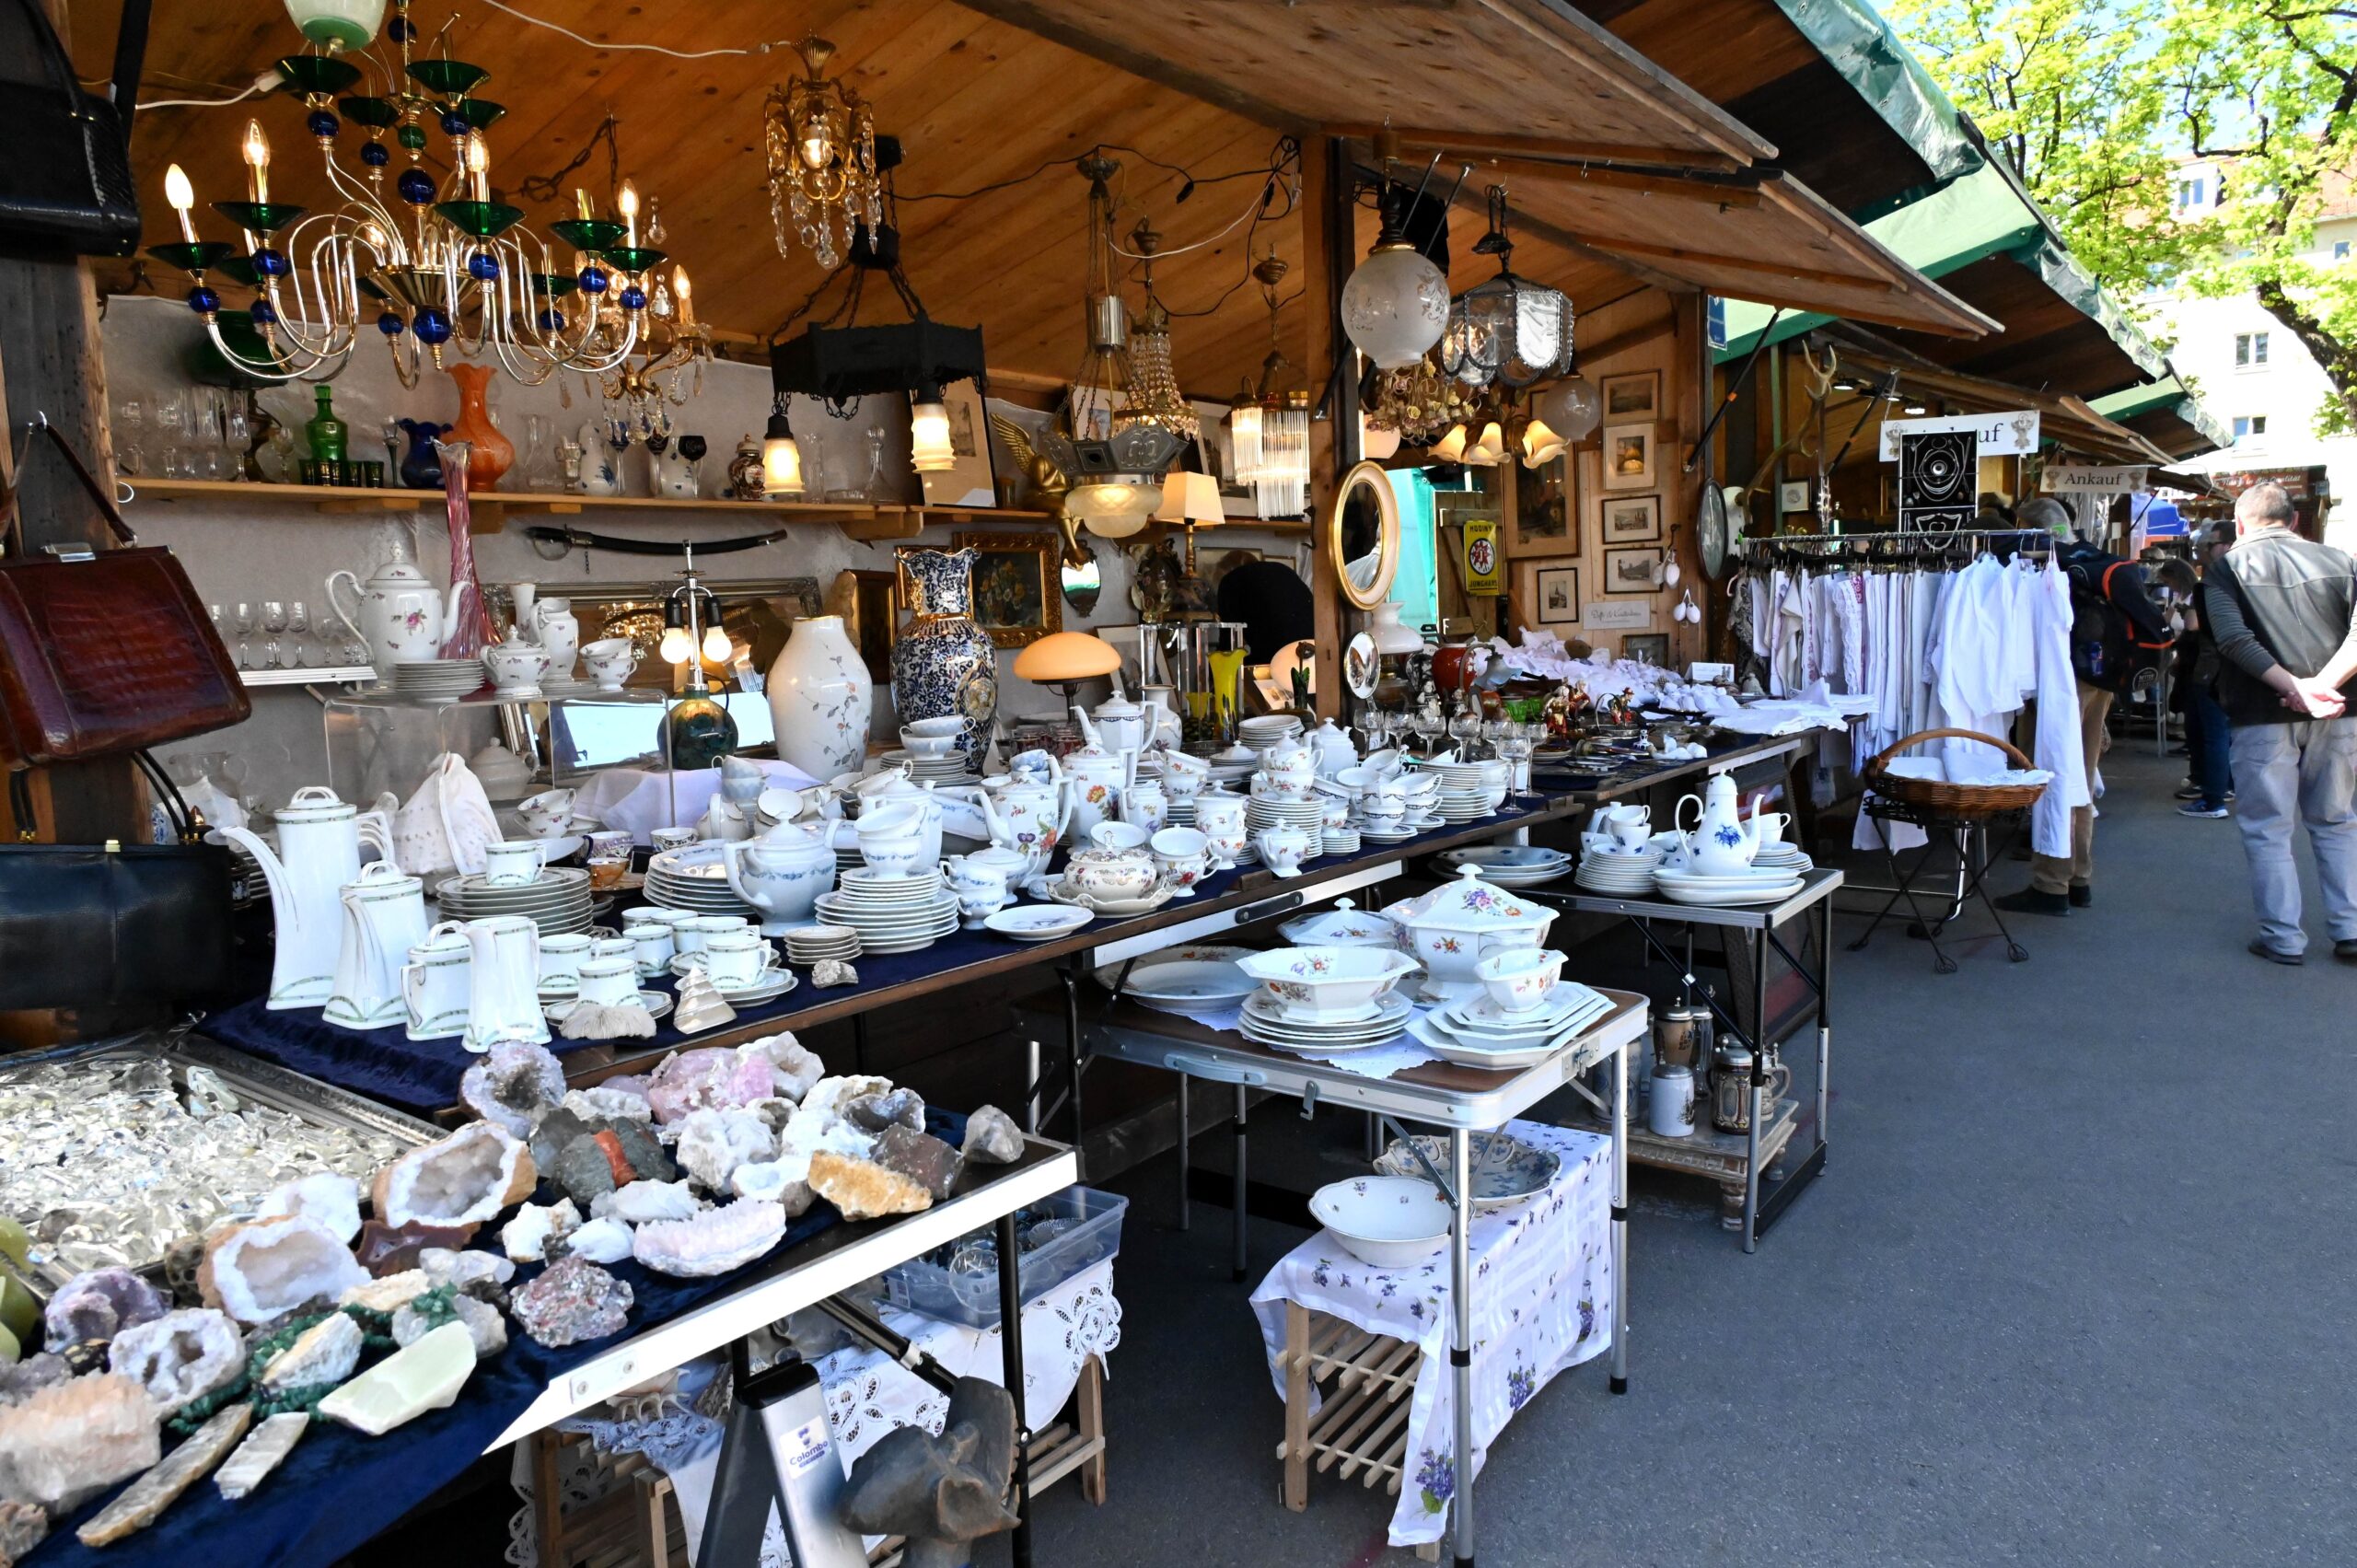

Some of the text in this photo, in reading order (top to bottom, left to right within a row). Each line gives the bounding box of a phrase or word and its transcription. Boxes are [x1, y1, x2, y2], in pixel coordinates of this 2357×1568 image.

[2063, 472, 2124, 486] Ankauf
[1469, 579, 1497, 588] JUNGHANS
[789, 1440, 829, 1466] Colombo
